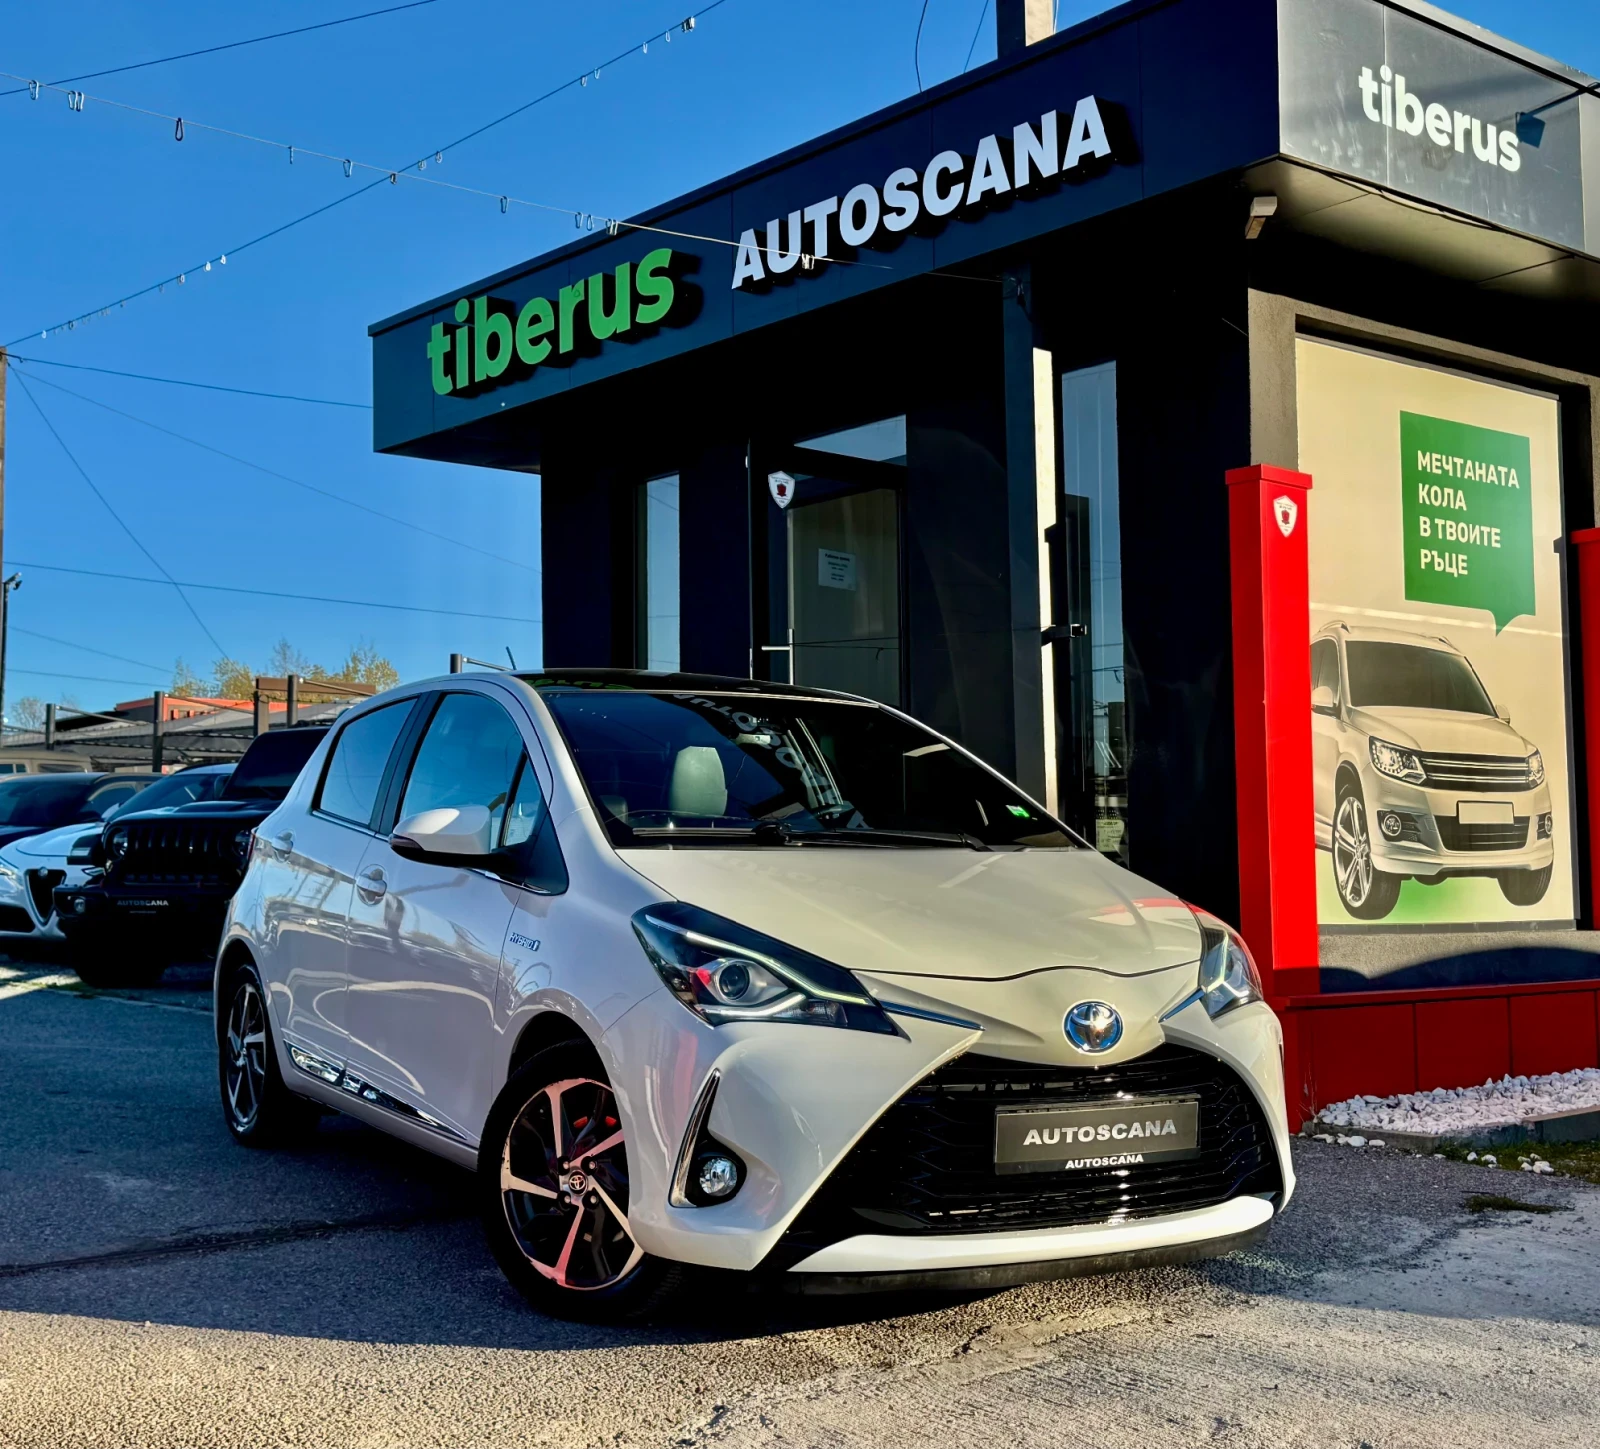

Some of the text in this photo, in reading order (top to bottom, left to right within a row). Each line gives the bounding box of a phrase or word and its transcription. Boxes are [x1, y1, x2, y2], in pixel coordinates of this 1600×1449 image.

[1358, 65, 1521, 172] tiberus
[731, 94, 1111, 289] AUTOSCANA
[426, 248, 675, 395] tiberus
[1417, 450, 1520, 489] МЕЧТАНАТА
[1418, 483, 1467, 511] КОЛА
[1419, 516, 1501, 548] В ТВОИТЕ
[1420, 549, 1468, 578] РЪЦЕ
[1022, 1119, 1177, 1146] AUTOSCANA
[1065, 1153, 1144, 1169] AUTOSCANA
